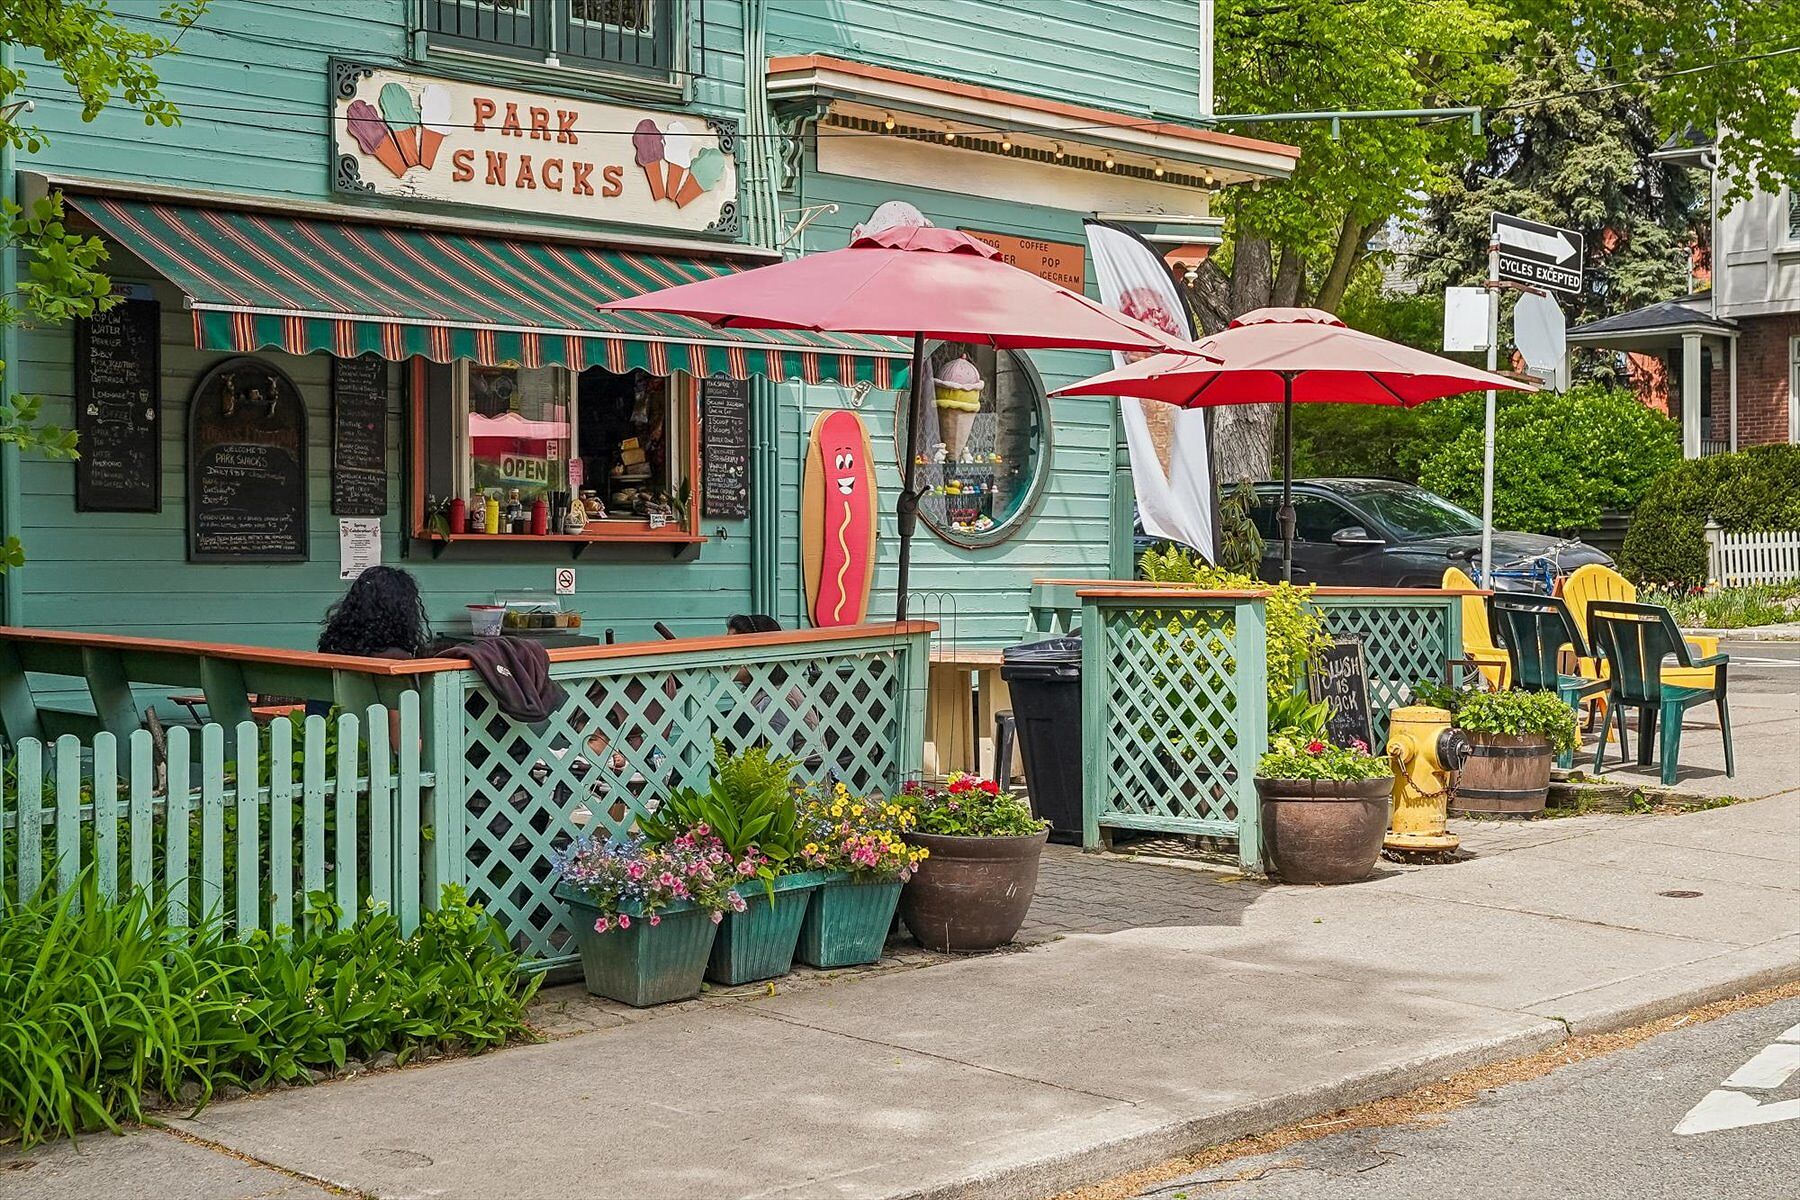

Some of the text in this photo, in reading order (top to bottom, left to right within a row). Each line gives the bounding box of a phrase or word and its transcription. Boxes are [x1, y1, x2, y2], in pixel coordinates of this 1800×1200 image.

[473, 97, 579, 145] PARK
[452, 149, 624, 198] SNACKS
[1019, 239, 1049, 252] COFFEE
[1041, 256, 1061, 268] POP
[1039, 270, 1080, 284] ICECREAM
[1499, 258, 1580, 288] CYCLES EXCEPTED
[215, 453, 269, 468] PARK SNACKS
[503, 457, 547, 481] OPEN
[1319, 654, 1361, 690] SLUSH
[1336, 678, 1349, 695] IS
